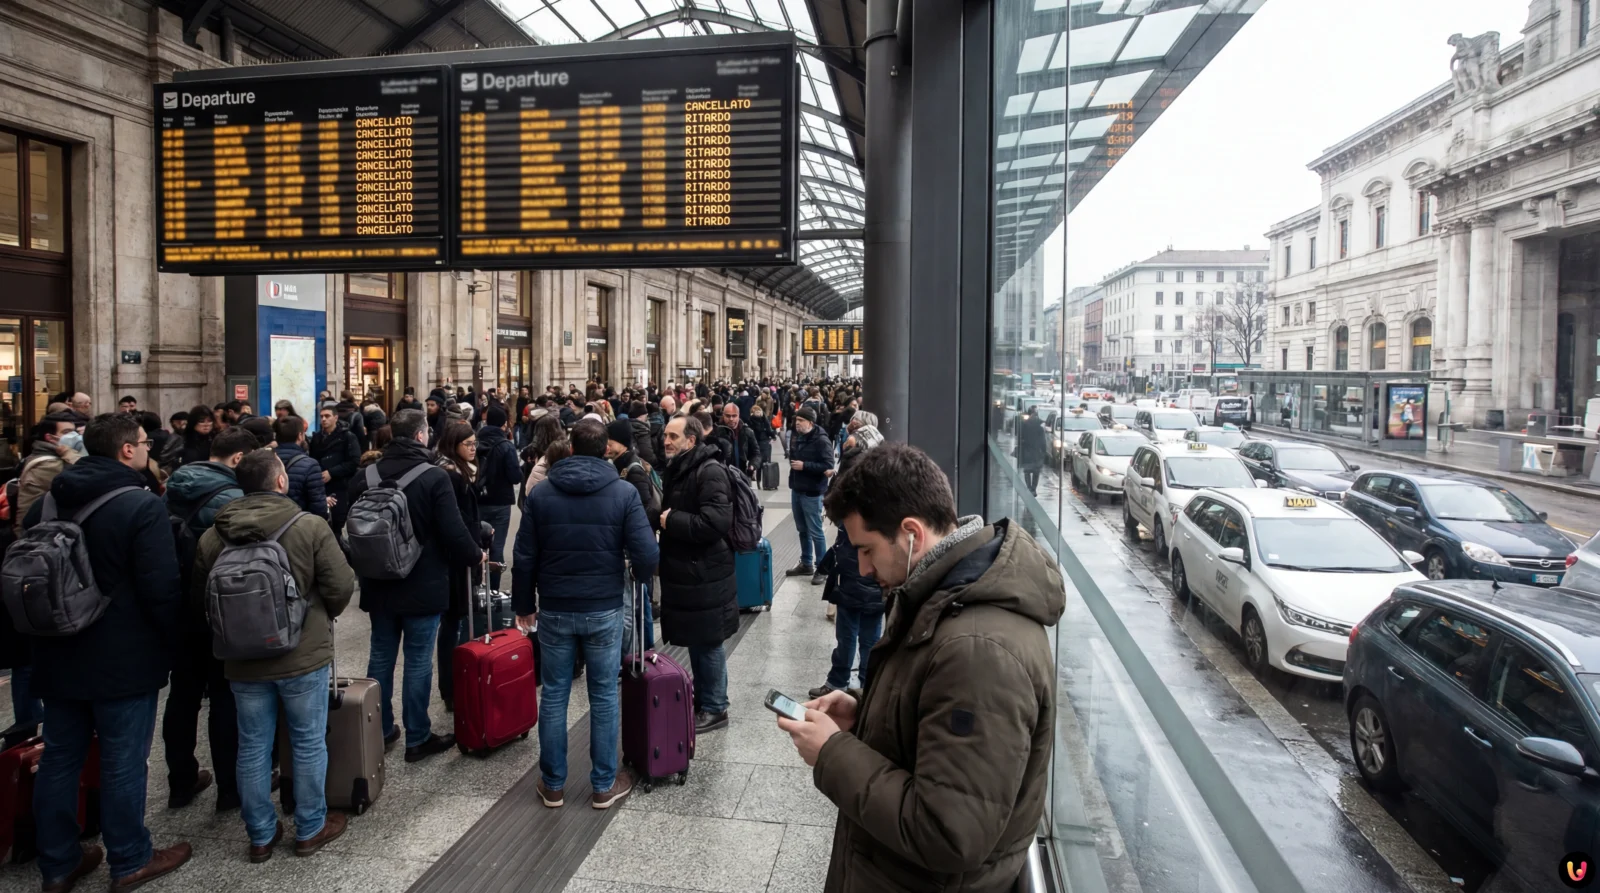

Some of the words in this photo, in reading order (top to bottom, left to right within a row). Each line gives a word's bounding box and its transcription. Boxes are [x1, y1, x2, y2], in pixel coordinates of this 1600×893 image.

[483, 71, 569, 92] Departure
[182, 90, 256, 110] Departure
[685, 99, 751, 111] CANCELLATO
[356, 116, 413, 127] CANCELLATO
[685, 112, 731, 122] RITARDO
[356, 127, 413, 138] CANCELLATO
[685, 124, 731, 134] RITARDO
[356, 138, 413, 149] CANCELLATO
[685, 136, 731, 145] RITARDO
[356, 149, 413, 160] CANCELLATO
[685, 147, 731, 157] RITARDO
[356, 160, 413, 170] CANCELLATO
[685, 159, 731, 169] RITARDO
[356, 171, 413, 181] CANCELLATO
[685, 170, 731, 180] RITARDO
[356, 182, 413, 192] CANCELLATO
[685, 182, 731, 192] RITARDO
[356, 192, 413, 202] CANCELLATO
[685, 194, 731, 203] RITARDO
[356, 203, 413, 213] CANCELLATO
[685, 205, 731, 215] RITARDO
[356, 214, 413, 224] CANCELLATO
[685, 217, 731, 226] RITARDO
[356, 225, 413, 234] CANCELLATO
